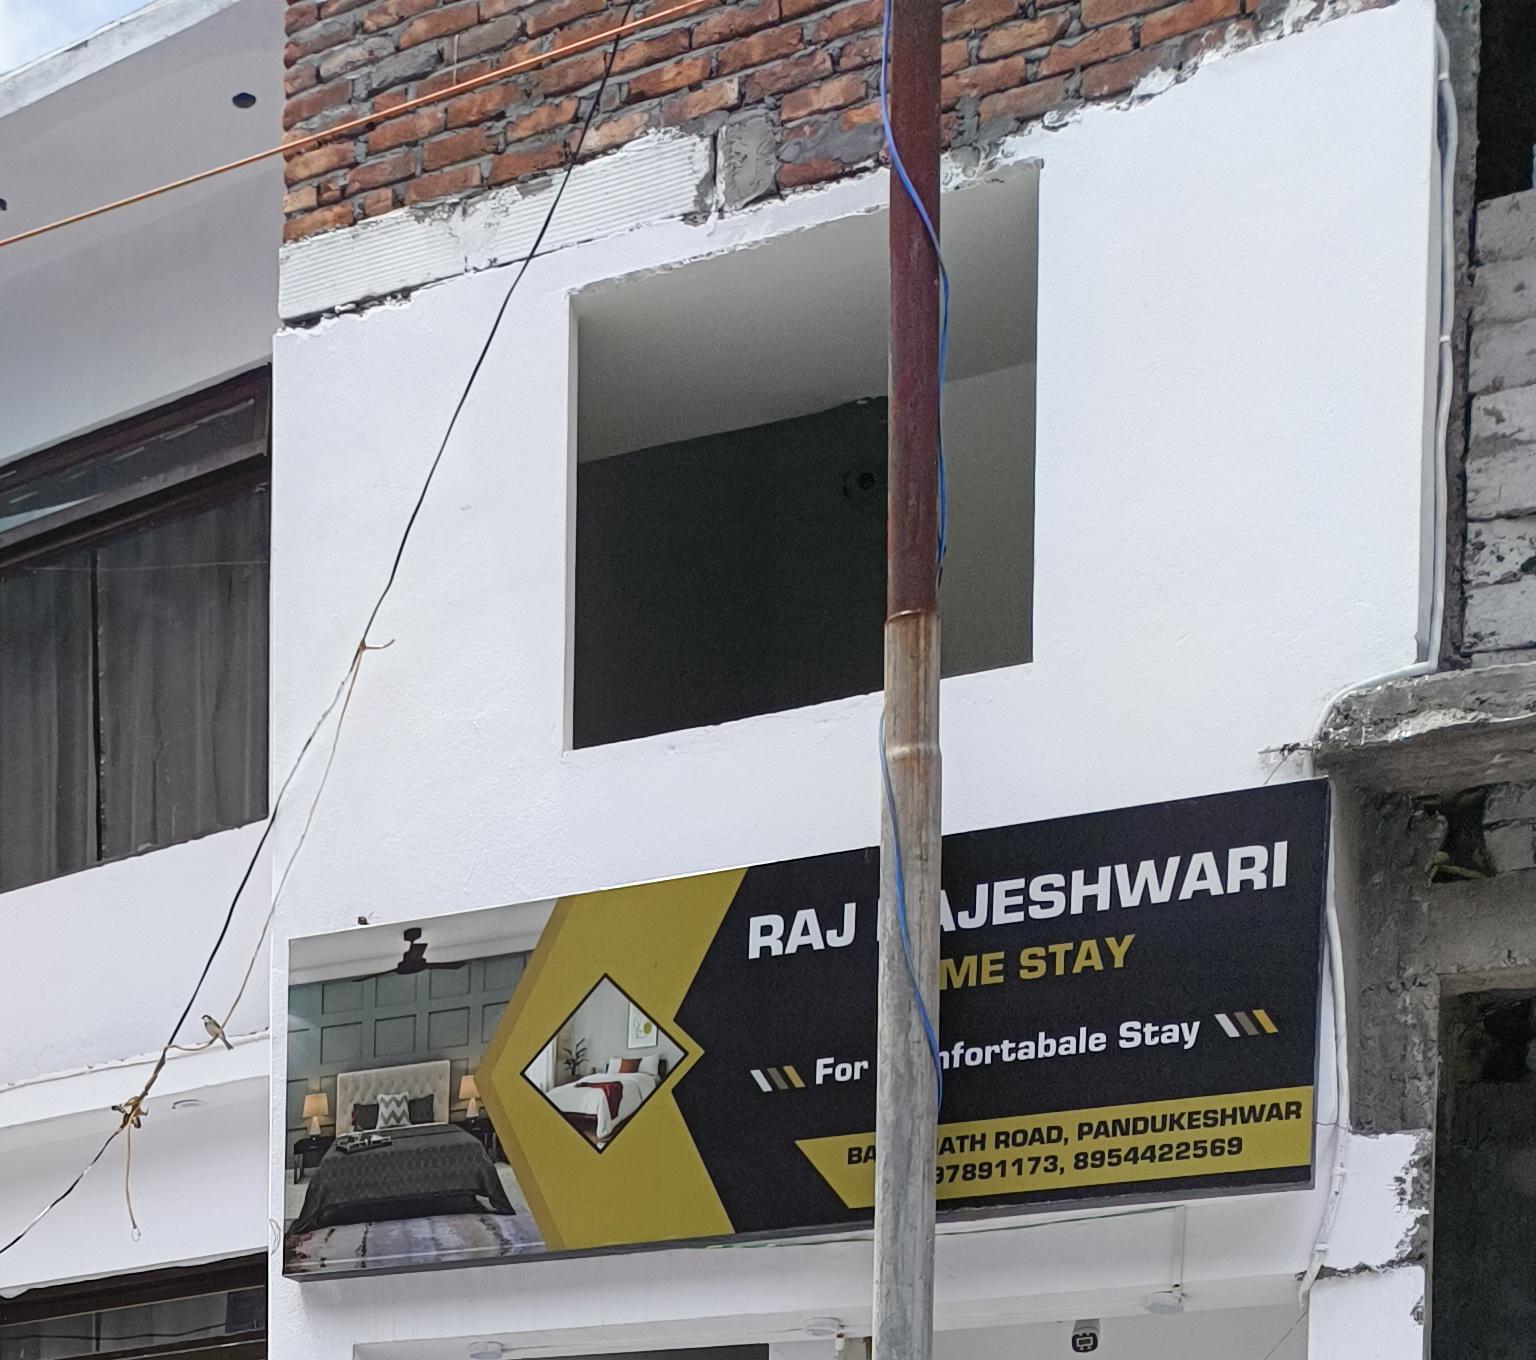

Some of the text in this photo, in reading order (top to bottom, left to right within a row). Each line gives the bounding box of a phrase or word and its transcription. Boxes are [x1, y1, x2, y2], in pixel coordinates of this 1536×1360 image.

[748, 841, 1288, 960] RAJ JESHWARI
[939, 934, 1135, 990] ME STAY
[815, 1057, 869, 1085] For
[1119, 1021, 1201, 1049] Stay
[847, 1100, 1303, 1165] BAATH ROAD, PANDUKESHWAR
[936, 1136, 1243, 1185] 97891173, 8954422569
